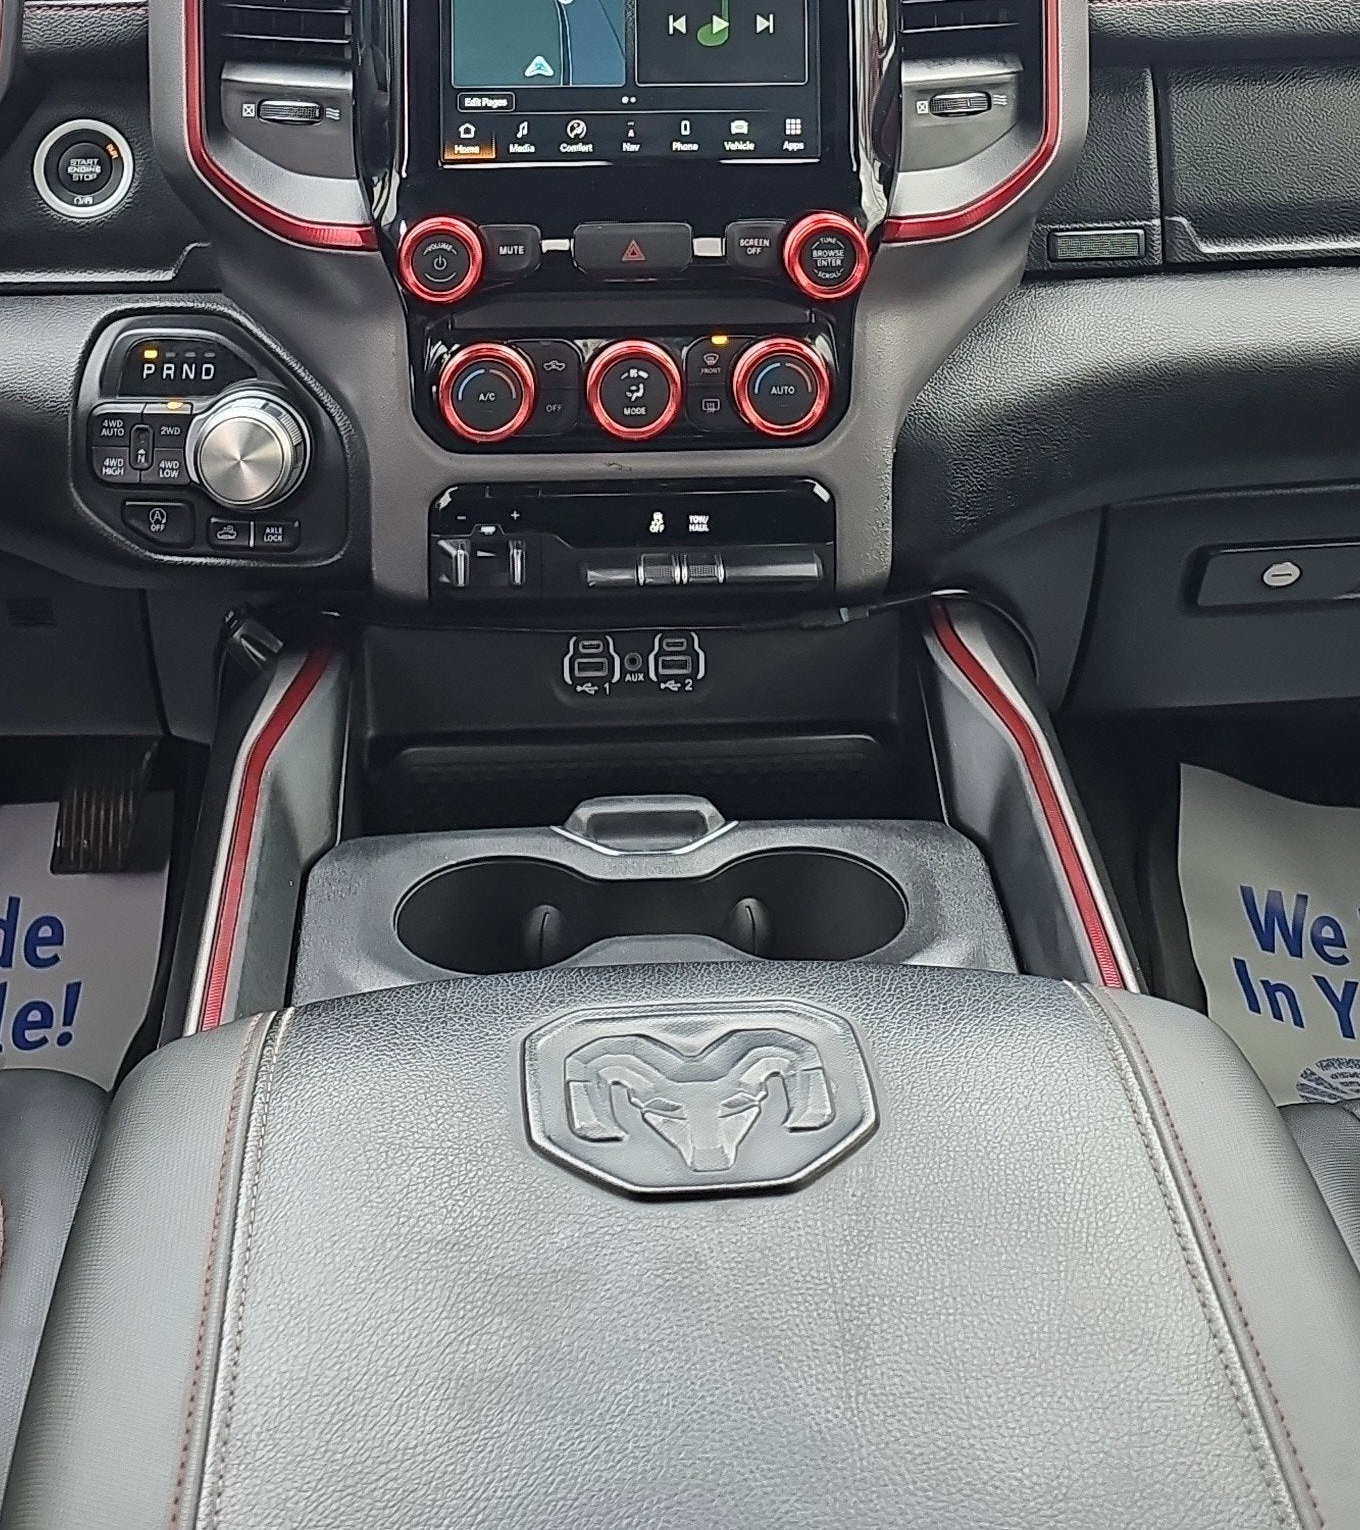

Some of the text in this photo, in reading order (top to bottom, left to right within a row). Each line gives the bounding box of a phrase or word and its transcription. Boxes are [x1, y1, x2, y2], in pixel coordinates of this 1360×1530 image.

[482, 98, 508, 108] Pages
[454, 141, 805, 154] Home Media Comfort Nav Phone Vehicle Apps
[70, 158, 99, 166] START
[67, 165, 102, 173] ENGINE
[72, 173, 97, 181] STOP
[740, 238, 770, 247] SCREEN
[499, 245, 525, 255] MUTE
[747, 247, 762, 255] OFF
[812, 250, 845, 258] BROWSE
[817, 258, 842, 267] ENTER
[816, 270, 842, 279] SCROLL
[770, 385, 795, 395] AUTO
[478, 392, 496, 402] A/C
[546, 404, 562, 413] OFF
[623, 406, 647, 416] MODE
[102, 419, 123, 427] 4WD
[100, 428, 125, 437] AUTO
[160, 426, 181, 435] 2WD
[103, 459, 124, 467] 4WD
[159, 460, 180, 469] 4WD
[102, 467, 124, 476] HIGH
[159, 469, 179, 478] LOW
[150, 523, 166, 532] OFF
[265, 526, 283, 534] AXLE
[264, 534, 283, 542] LOCK
[624, 673, 645, 682] AUX
[603, 682, 610, 696] 1
[685, 679, 693, 691] 2
[1240, 883, 1351, 968] We
[1232, 955, 1306, 1031] In
